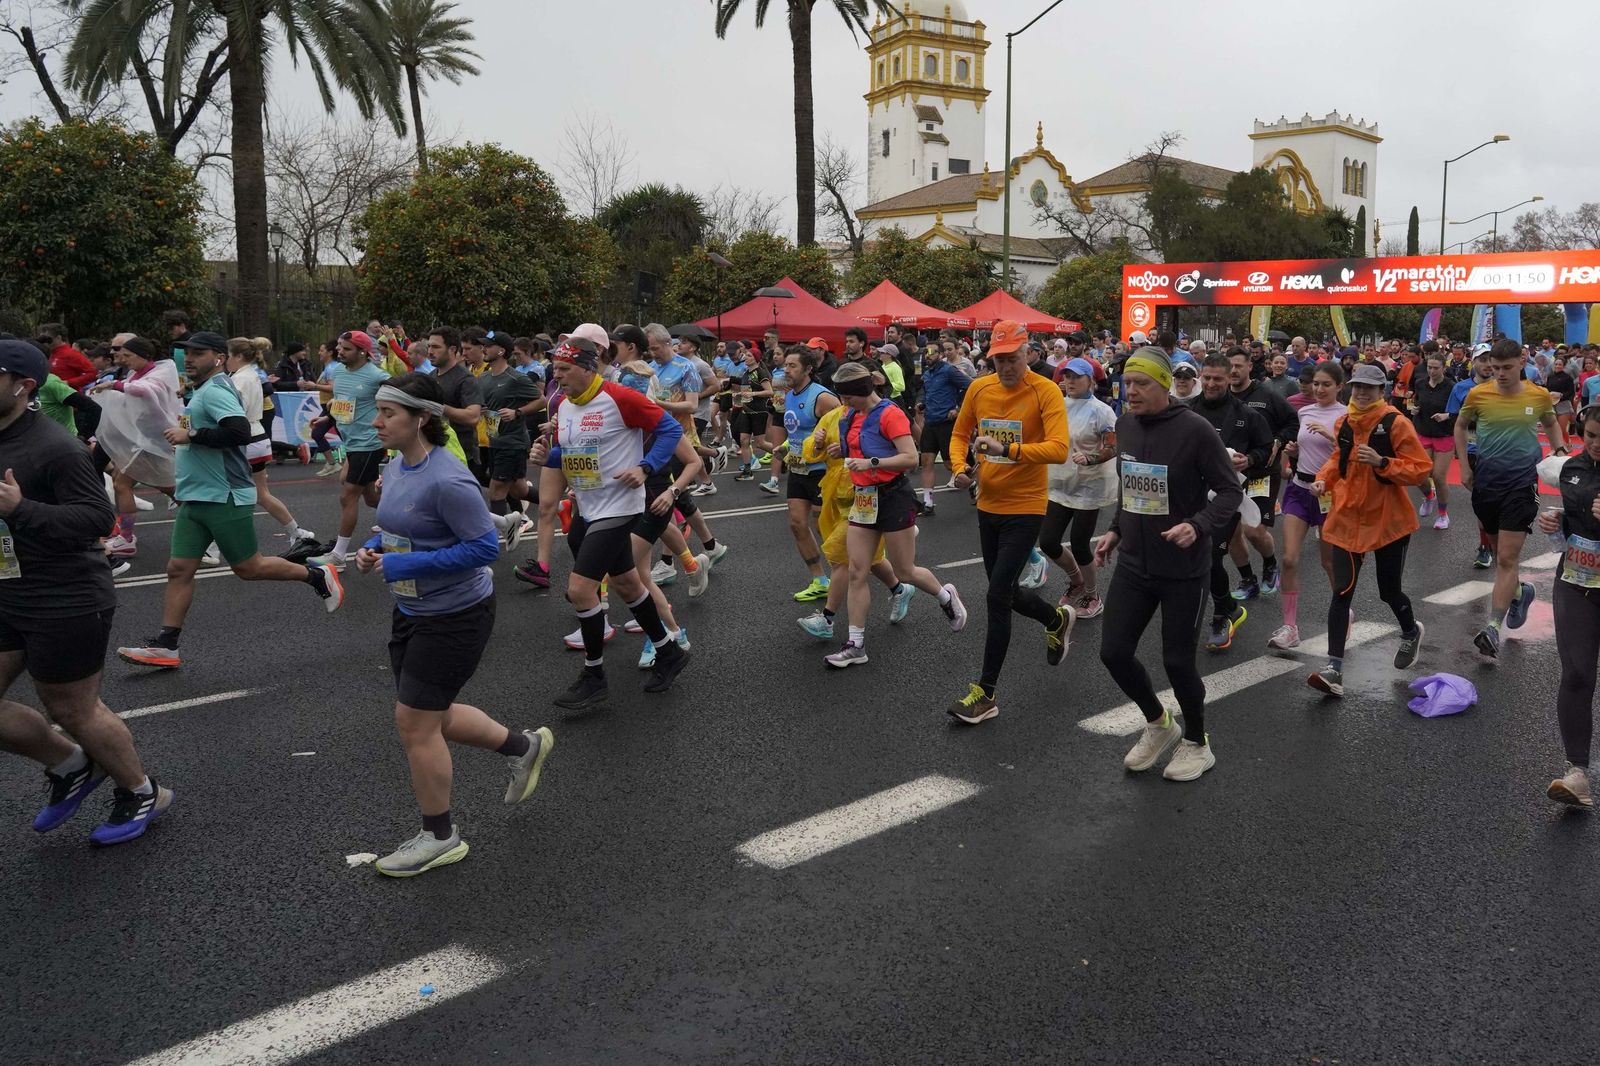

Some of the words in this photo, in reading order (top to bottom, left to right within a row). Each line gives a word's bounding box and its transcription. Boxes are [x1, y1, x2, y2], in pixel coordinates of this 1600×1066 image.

[1393, 264, 1466, 280] maratón
[1483, 272, 1546, 285] 00:11:50
[1202, 278, 1240, 288] Sprinter
[1280, 274, 1324, 290] HOKA
[1410, 277, 1466, 292] sevilla
[563, 456, 593, 471] 18506
[1124, 474, 1159, 493] 20686
